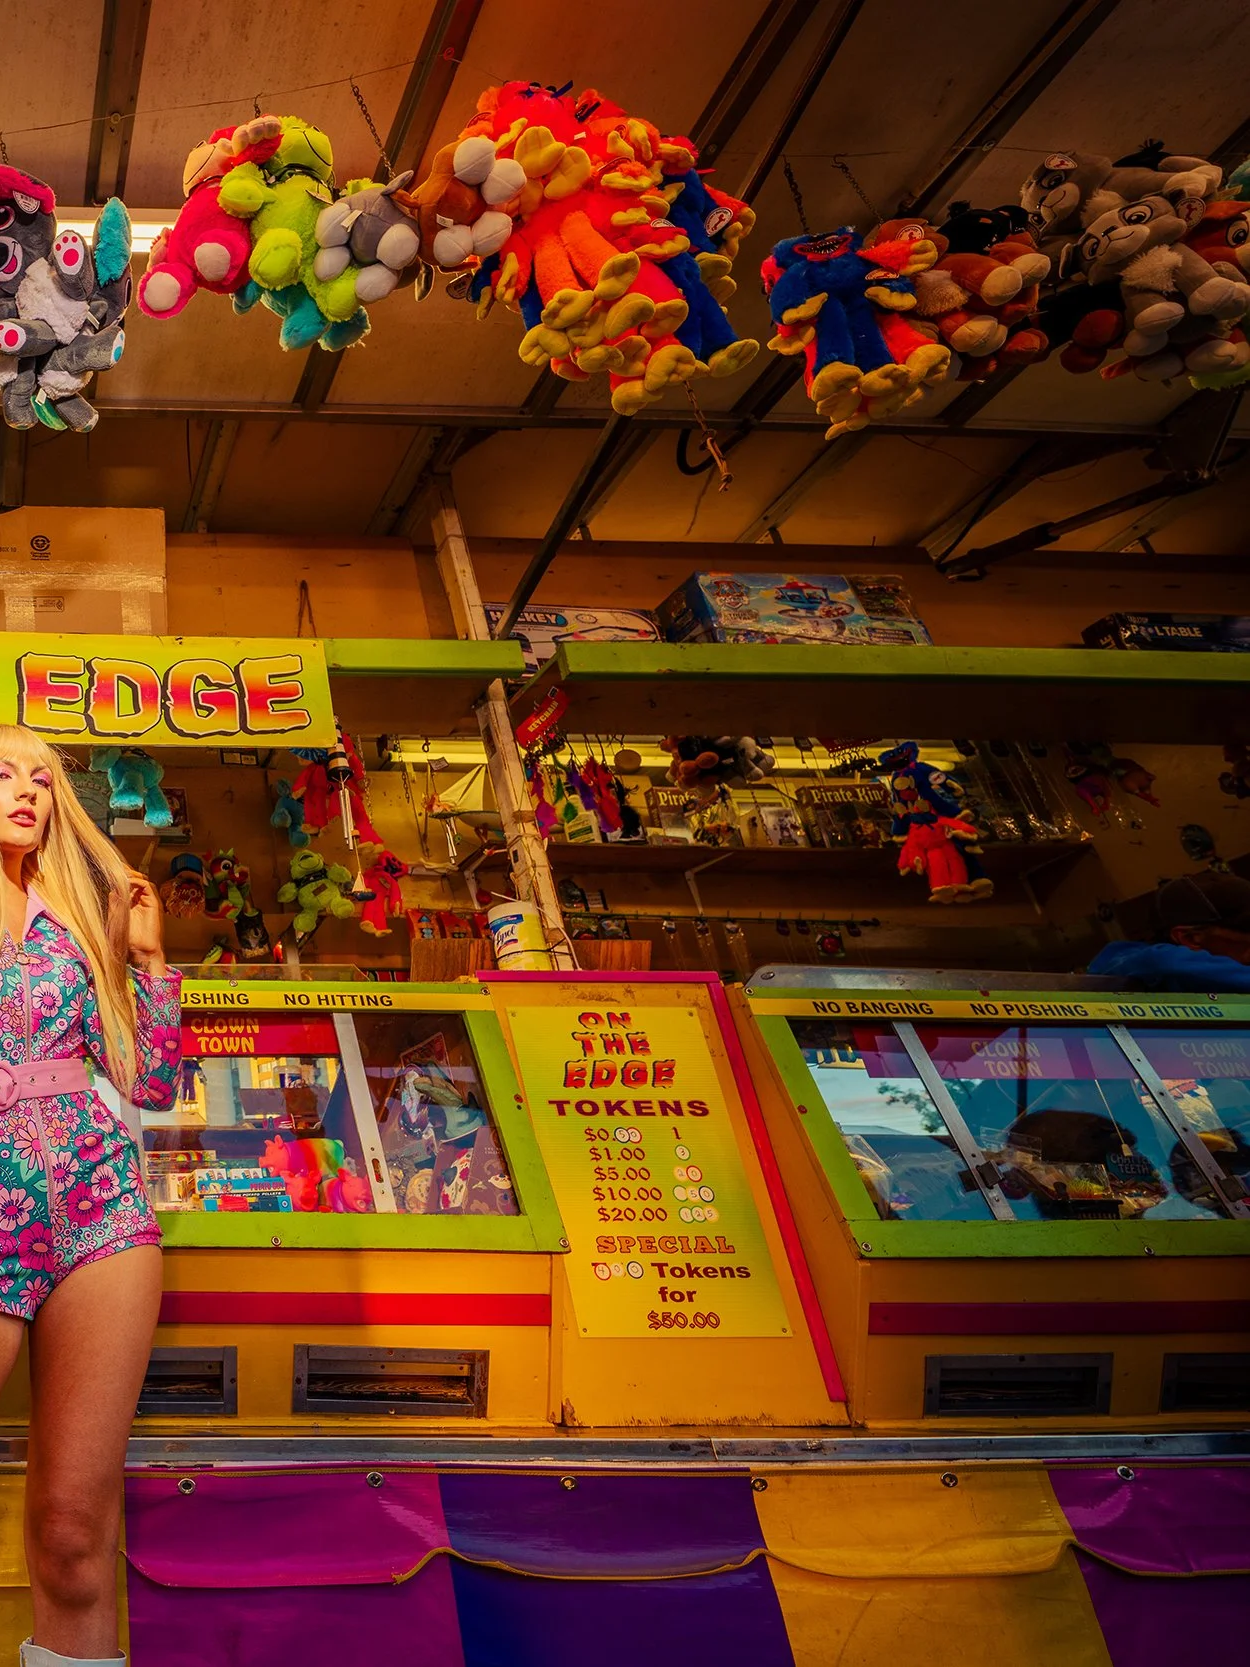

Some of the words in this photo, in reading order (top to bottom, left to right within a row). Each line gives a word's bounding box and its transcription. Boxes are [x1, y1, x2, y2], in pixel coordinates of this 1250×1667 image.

[15, 651, 311, 740] EDGE
[810, 788, 853, 803] Pirate
[284, 994, 311, 1006] NO
[317, 994, 393, 1007] HITTING
[813, 1001, 843, 1015] NO
[845, 1001, 934, 1016] BANGING
[969, 1002, 999, 1016] NO
[1002, 1004, 1089, 1018] PUSHING
[1118, 1004, 1149, 1018] NO
[1152, 1006, 1224, 1019] HITTING
[190, 1018, 260, 1034] CLOWN
[578, 1011, 632, 1029] ON
[197, 1037, 255, 1053] TOWN
[571, 1032, 652, 1057] THE
[970, 1040, 1041, 1059] CLOWN
[1179, 1041, 1246, 1059] CLOWN
[564, 1059, 676, 1089] EDGE
[984, 1060, 1044, 1078] TOWN
[548, 1100, 710, 1117] TOKENS
[589, 1146, 645, 1162] $1.00
[594, 1165, 651, 1181] $5.00
[1118, 1164, 1149, 1174] TEETH
[592, 1186, 662, 1202] $10.00
[597, 1206, 668, 1223] $20.00
[595, 1236, 736, 1254] SPECIAL
[651, 1262, 751, 1279] Tokens
[658, 1286, 697, 1303] for
[647, 1310, 721, 1330] $50.00
